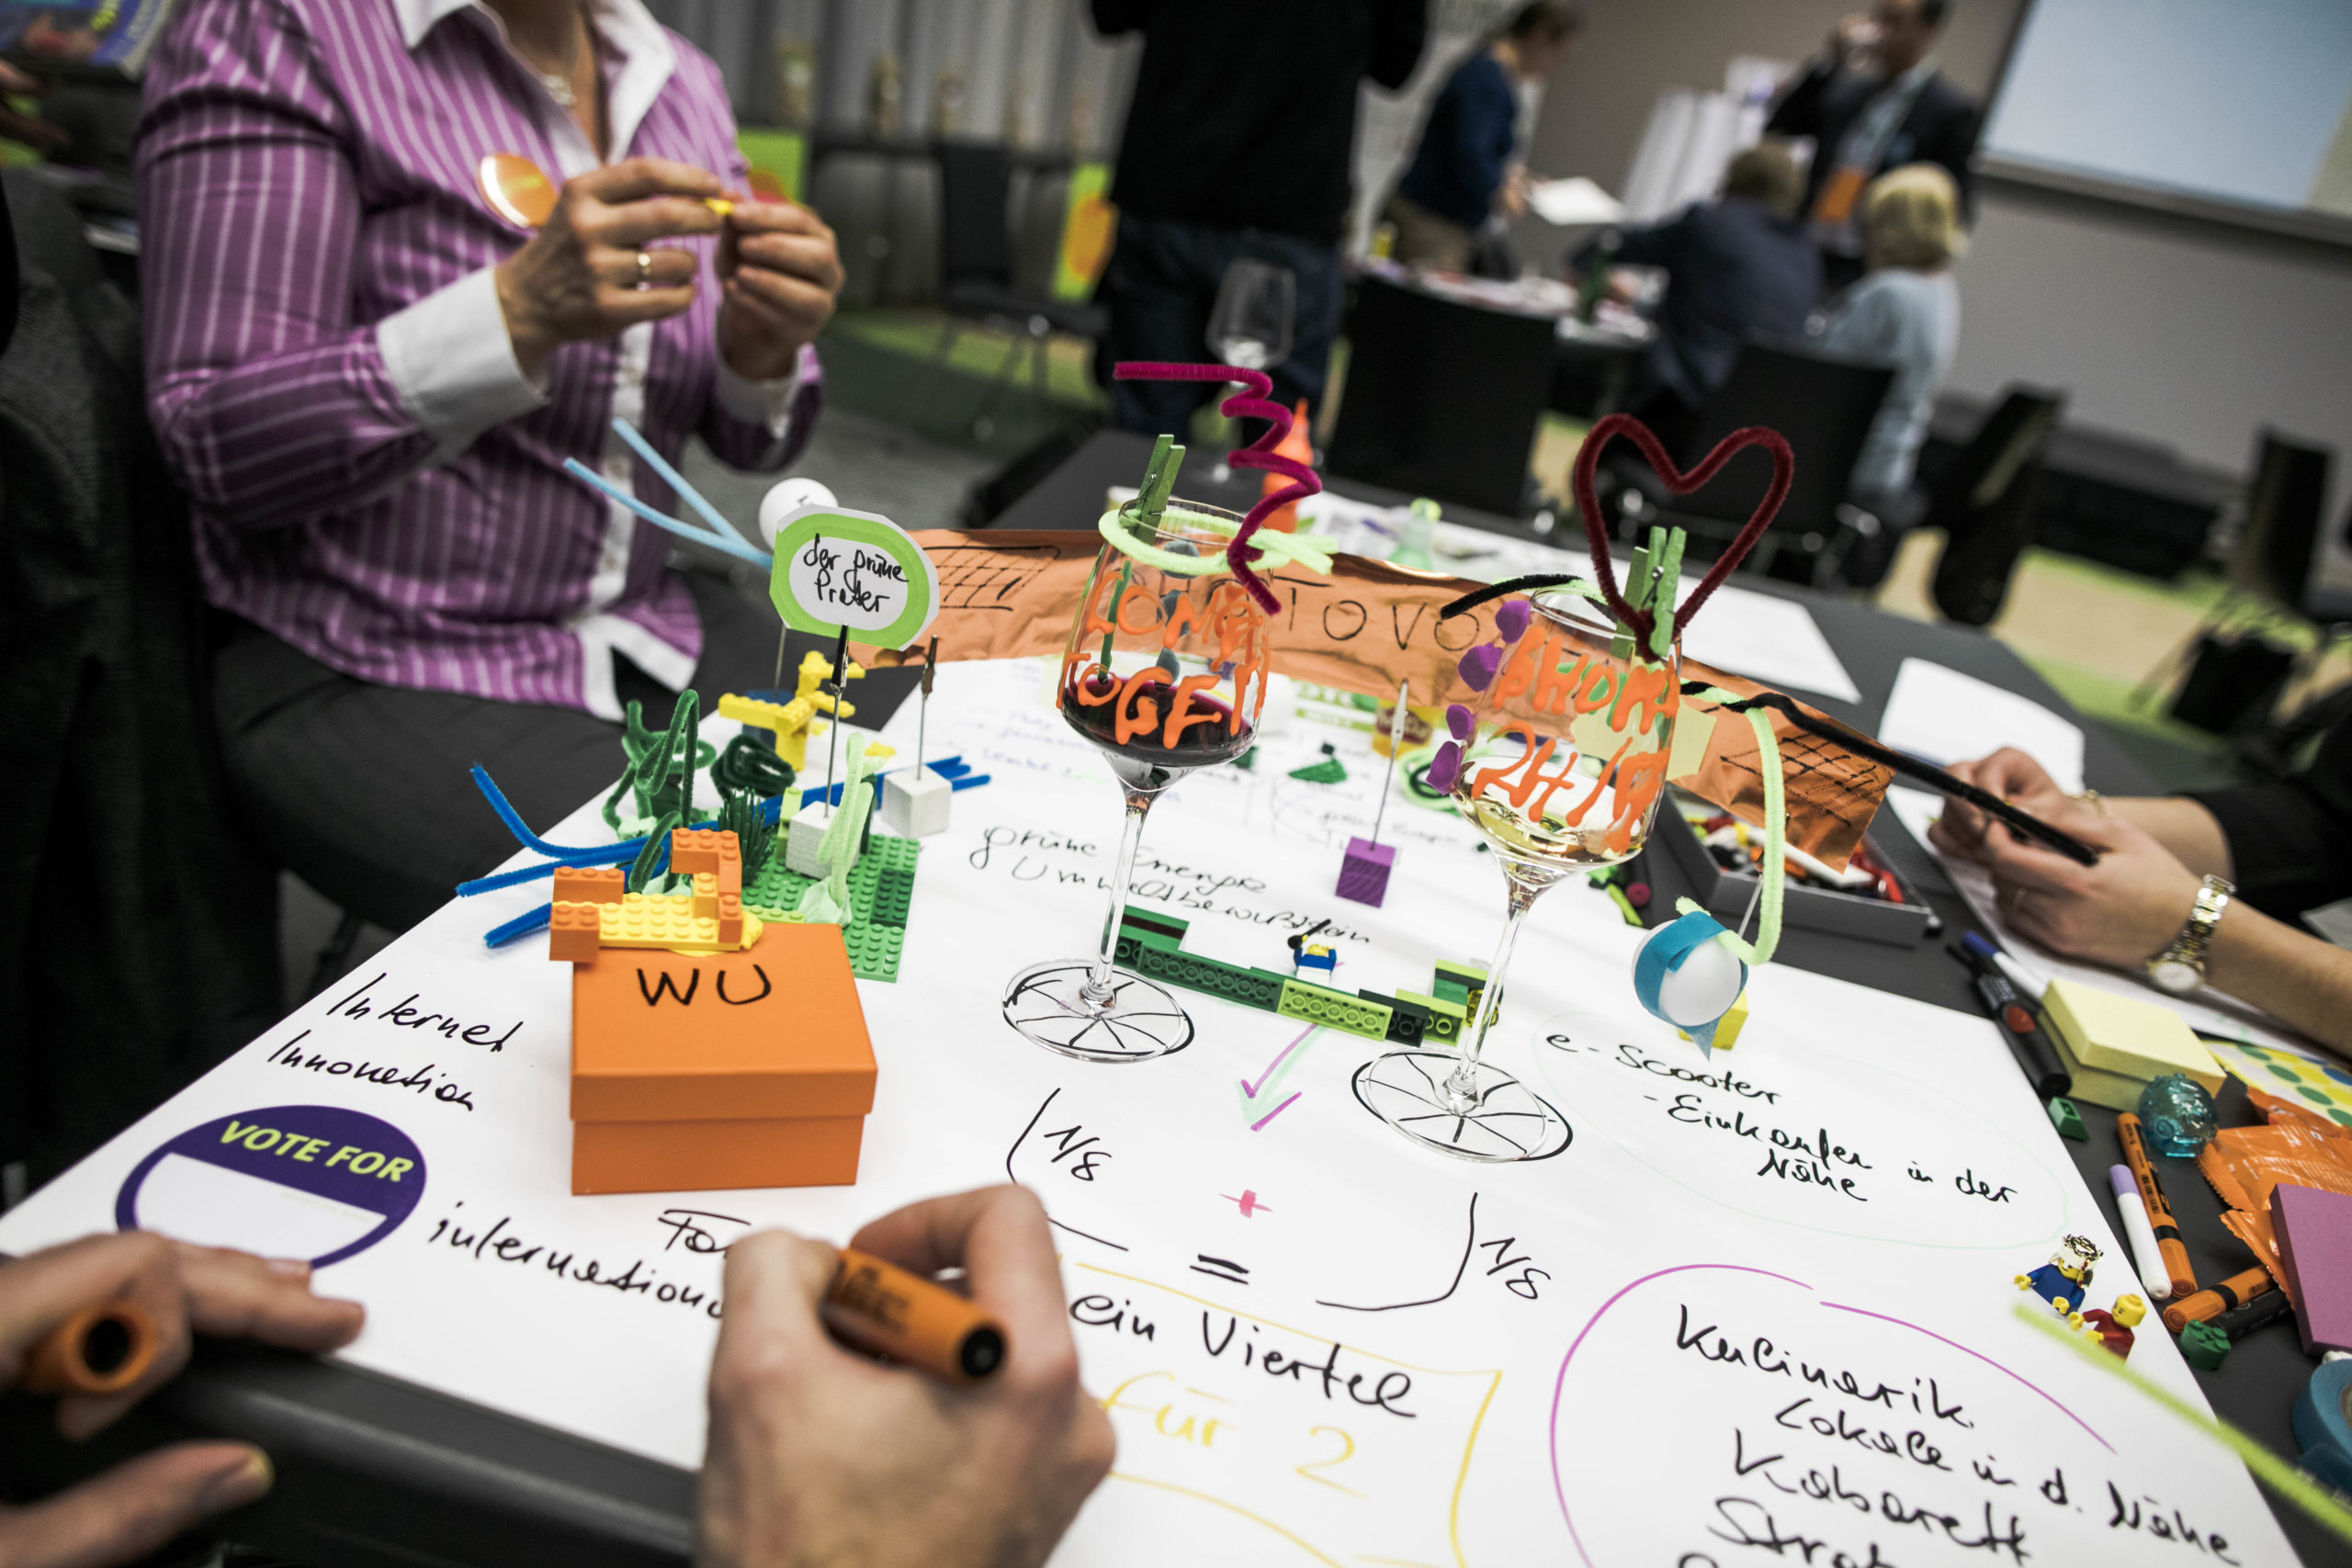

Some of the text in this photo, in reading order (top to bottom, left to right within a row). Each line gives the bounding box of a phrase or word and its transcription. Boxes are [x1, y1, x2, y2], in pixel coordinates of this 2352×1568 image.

[326, 972, 524, 1052] Internet
[220, 1121, 414, 1182] VOTE FOR
[1044, 1124, 1113, 1182] 1/8
[1955, 1168, 2018, 1203] der
[1479, 1237, 1552, 1300] 1/8
[1069, 1293, 1418, 1418] ein Viertel
[1295, 1426, 1371, 1500] 2
